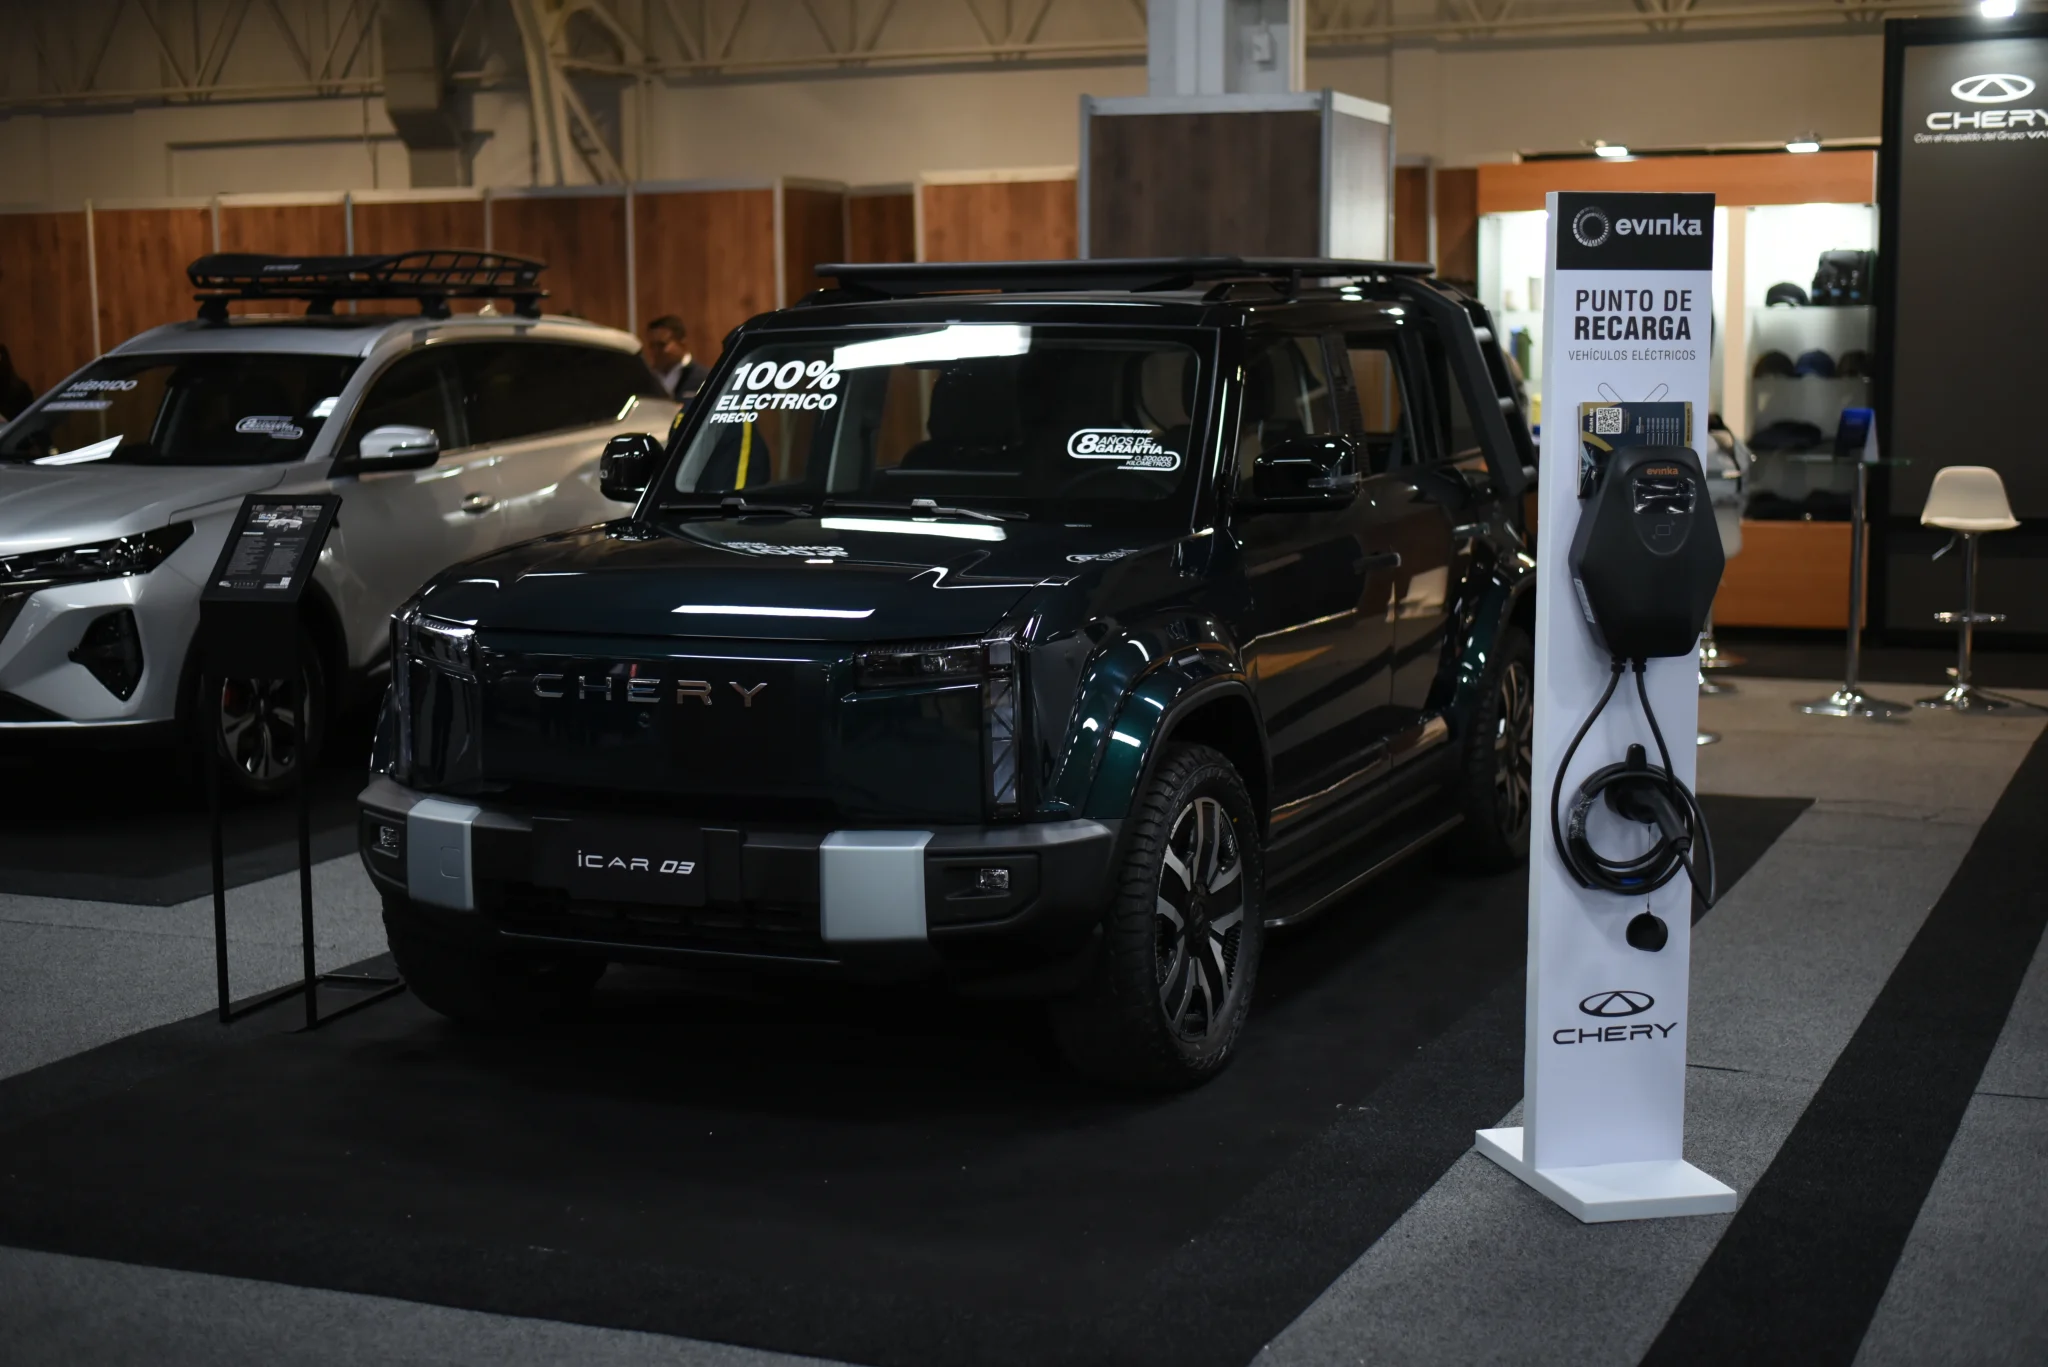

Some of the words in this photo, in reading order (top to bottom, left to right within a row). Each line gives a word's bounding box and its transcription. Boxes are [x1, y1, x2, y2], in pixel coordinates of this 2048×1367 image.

[2026, 130, 2048, 139] VA
[1615, 213, 1702, 236] evinka
[1575, 289, 1654, 312] PUNTO
[1664, 289, 1692, 312] DE
[1574, 315, 1692, 341] RECARGA
[1568, 348, 1628, 361] VEHÍCULOS
[1631, 348, 1696, 361] ELÉCTRICOS
[731, 360, 841, 391] 100%
[715, 393, 838, 411] ELECTRICO
[709, 412, 759, 424] PRECIO
[1076, 434, 1100, 453] 8
[1098, 434, 1134, 446] AÑOS
[1135, 437, 1154, 447] DE
[1095, 443, 1163, 455] GARANTÍA
[1646, 467, 1679, 475] evinka
[533, 673, 768, 707] CHERY
[577, 849, 650, 872] iCAR
[659, 859, 696, 875] 03
[1552, 1021, 1678, 1045] CHERY
